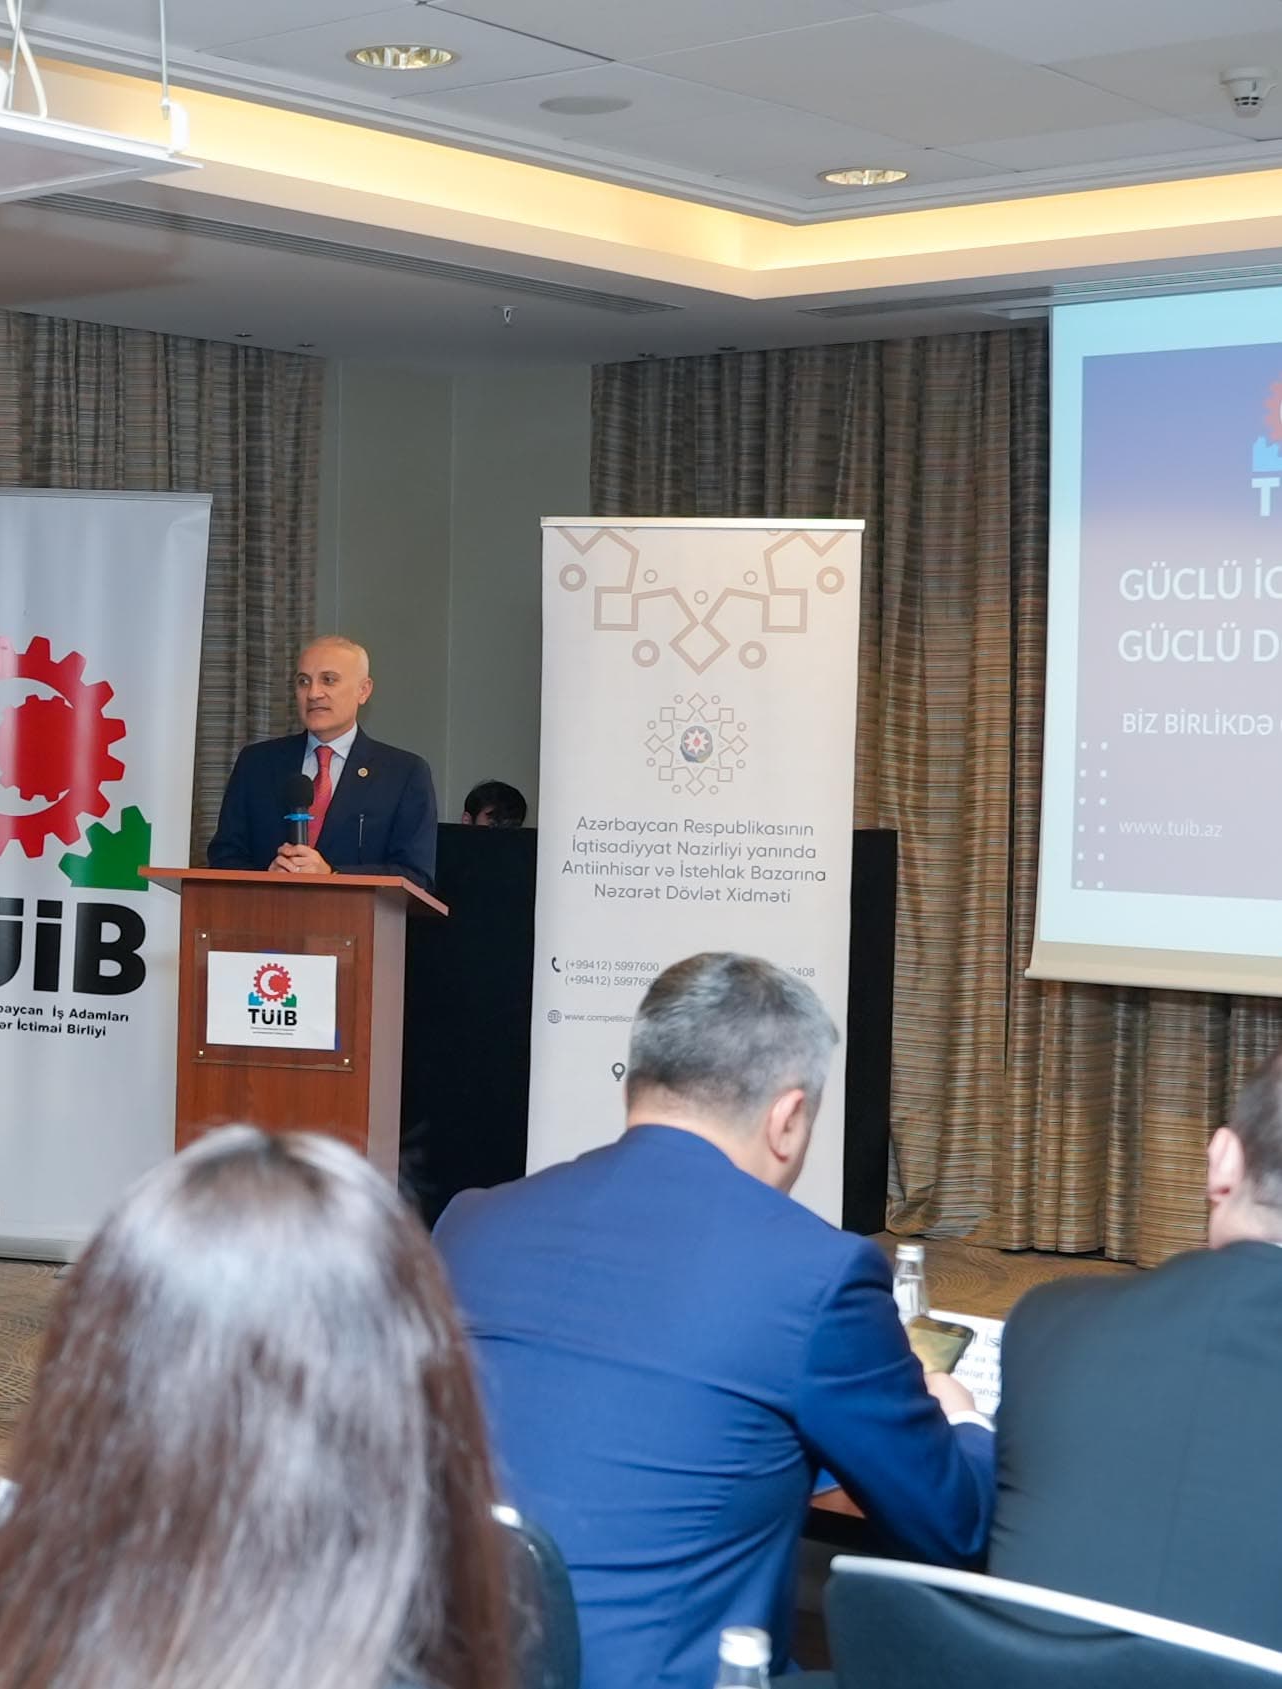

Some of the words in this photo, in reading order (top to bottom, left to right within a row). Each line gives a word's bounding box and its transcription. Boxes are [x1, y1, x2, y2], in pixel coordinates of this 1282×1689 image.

[1119, 560, 1243, 601] GÜCLÜ
[1118, 621, 1242, 663] GÜCLÜ
[1122, 708, 1158, 734] BİZ
[1164, 708, 1274, 736] BİRLİKDƏ
[576, 816, 678, 835] Azərbaycan
[684, 819, 814, 837] Respublikasının
[1118, 818, 1223, 838] www.tuib.az
[572, 834, 672, 857] İqtisadiyyat
[677, 841, 742, 860] Nazirliyi
[746, 845, 816, 860] yanında
[561, 860, 650, 877] Antiinhisar
[655, 866, 675, 877] və
[680, 860, 745, 879] İstehlak
[750, 865, 826, 882] Bazarına
[594, 883, 661, 900] Nəzarət
[666, 885, 721, 901] Dövlət
[726, 887, 791, 904] Xidməti
[52, 1004, 64, 1019] İş
[69, 1008, 129, 1023] Adamları
[17, 1020, 62, 1034] İctimai
[67, 1023, 107, 1038] Birliyi
